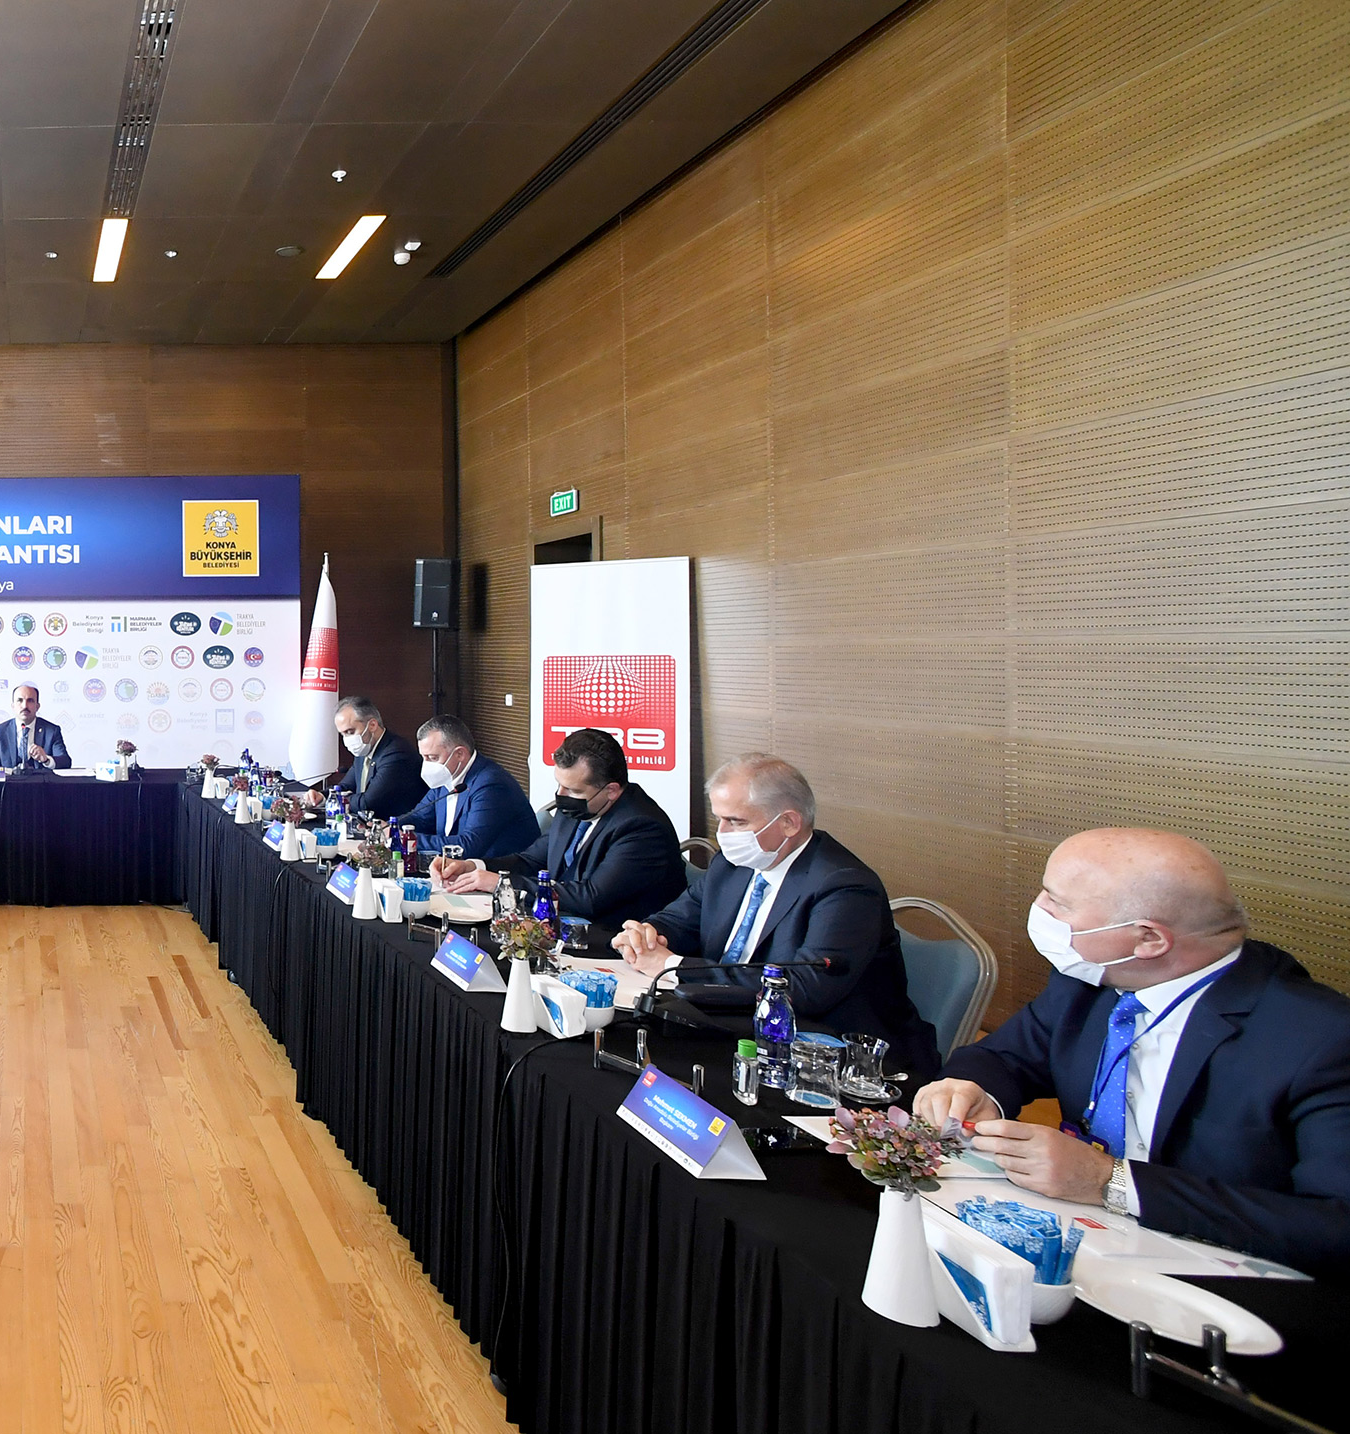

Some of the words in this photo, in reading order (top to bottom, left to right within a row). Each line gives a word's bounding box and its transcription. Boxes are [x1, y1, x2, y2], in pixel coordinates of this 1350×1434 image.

[554, 495, 571, 511] EXIT
[190, 550, 252, 561] BÜYÜKŞEHİR
[636, 756, 666, 765] BİRLİĞİ
